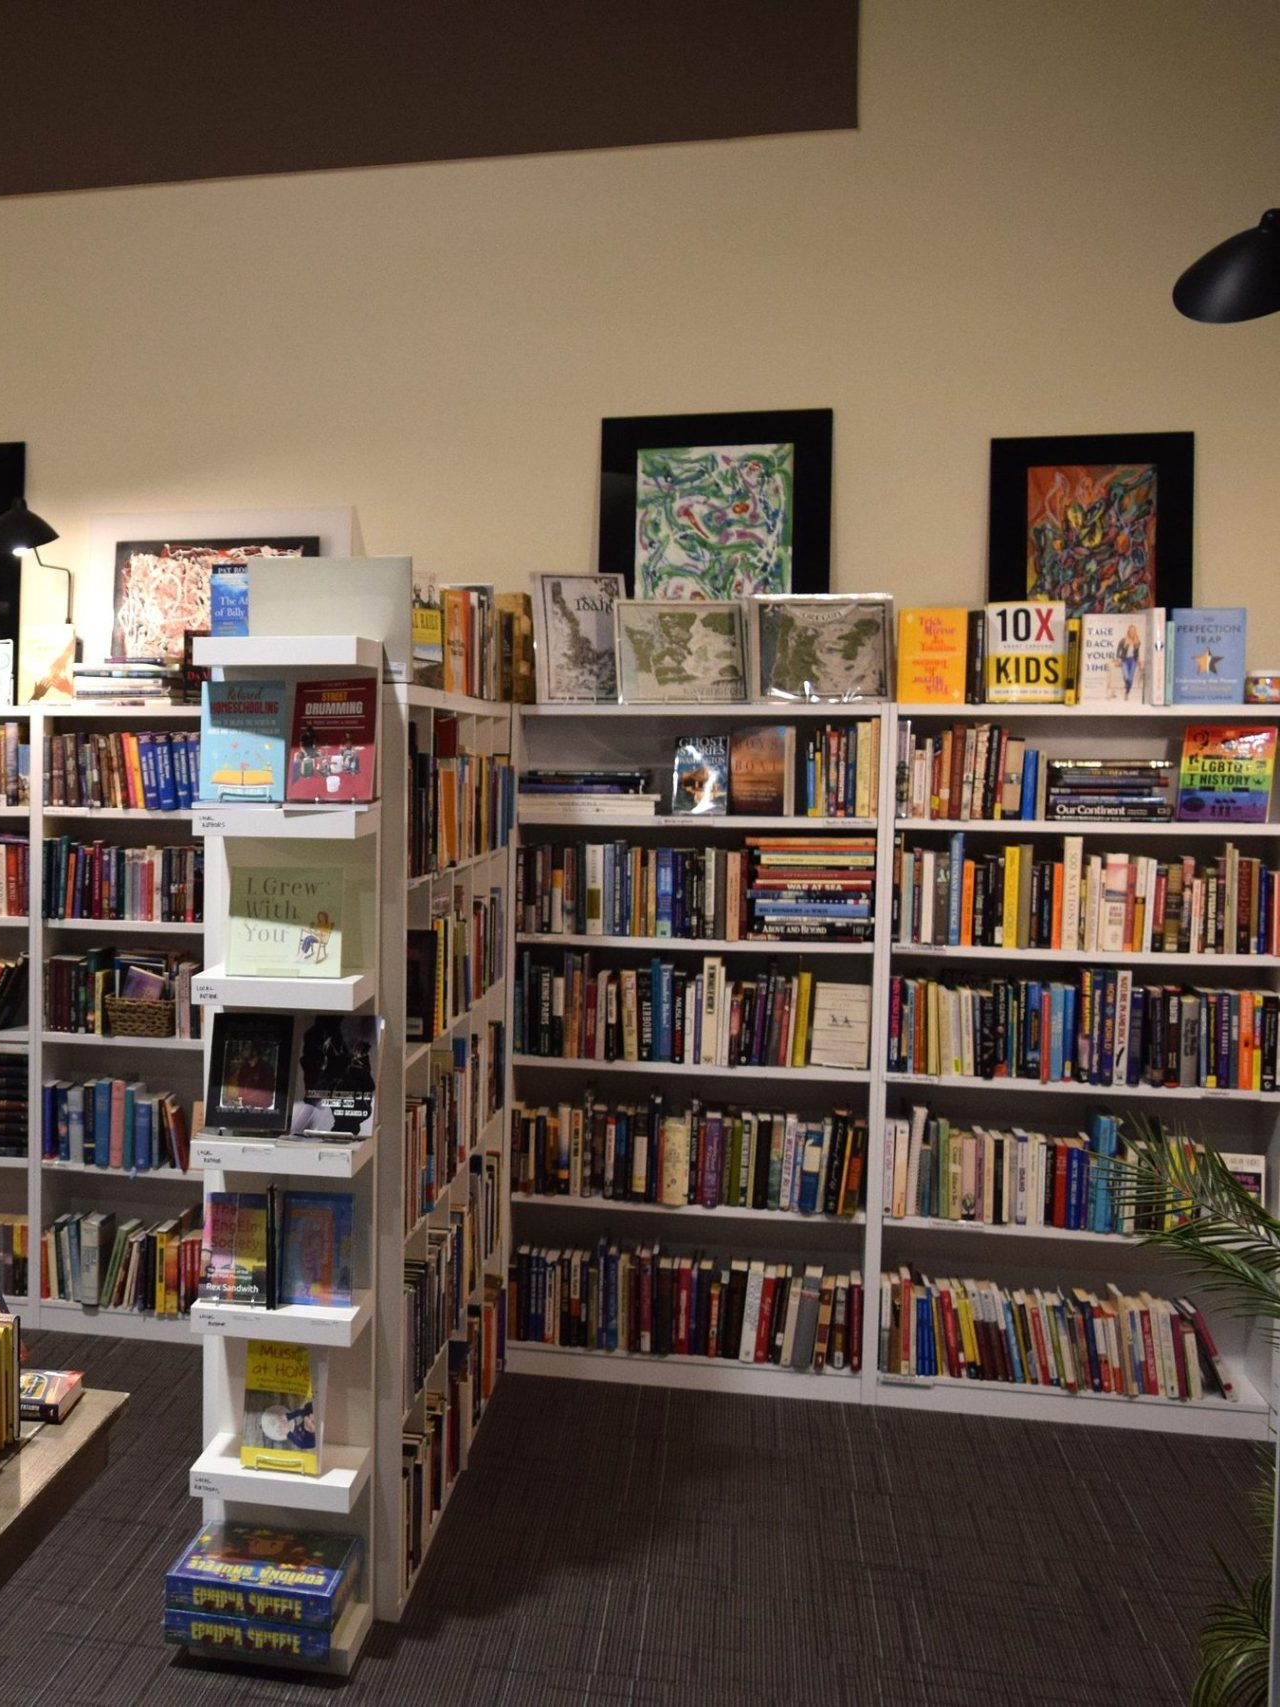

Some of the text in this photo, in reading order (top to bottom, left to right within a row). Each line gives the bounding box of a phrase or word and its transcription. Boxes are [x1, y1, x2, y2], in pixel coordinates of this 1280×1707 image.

[995, 607, 1055, 642] 10X
[1087, 627, 1114, 636] TAKE
[1176, 625, 1241, 634] PERFECTION
[1086, 639, 1114, 648] BACK
[1195, 635, 1222, 644] TRAP
[1086, 651, 1115, 660] YOUR
[995, 656, 1060, 684] KIDS
[304, 701, 364, 716] DRUMMING
[1199, 773, 1250, 786] HISTORY
[1081, 804, 1125, 815] Continent
[263, 877, 320, 896] Grew
[786, 883, 843, 891] WAR AT SEA
[1068, 873, 1078, 928] NATIONS
[245, 899, 300, 920] With
[242, 922, 287, 944] You
[762, 924, 827, 935] ABOVE AND BEYOND
[540, 969, 551, 1026] TAKING PARIS
[675, 996, 684, 1030] MUSLIM
[206, 1282, 259, 1294] Rex Sandwith
[275, 1364, 310, 1382] HOME
[192, 1586, 303, 1621] ECHIDNA SHUFFLE
[191, 1621, 301, 1654] ECHIDNA SHUFFLE
